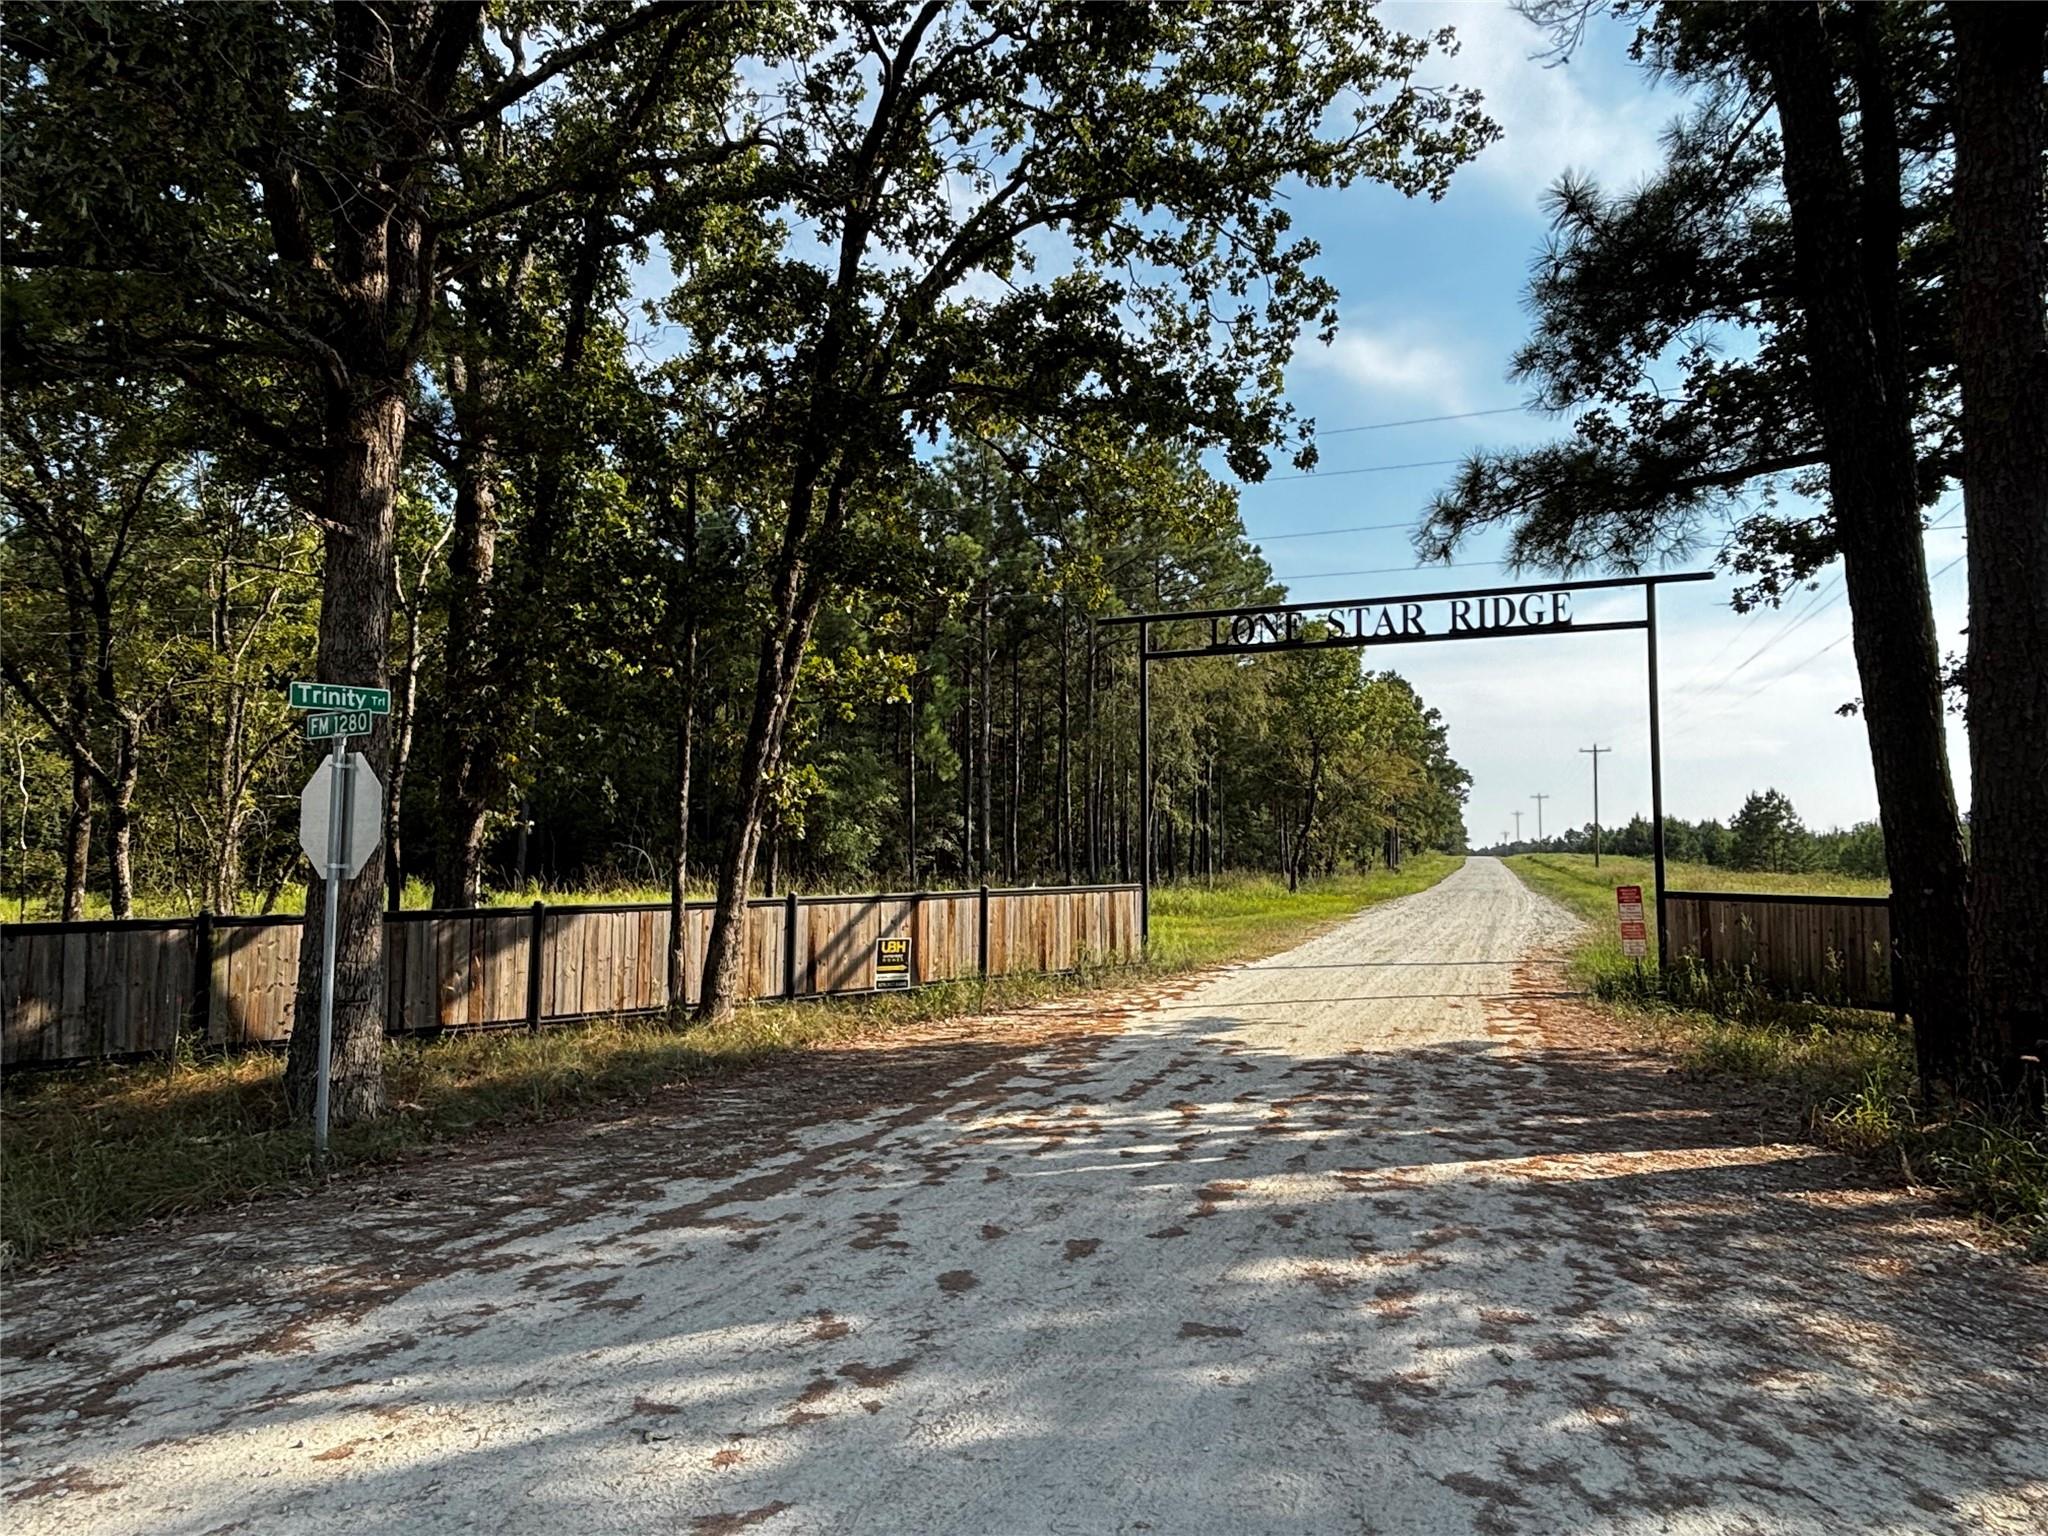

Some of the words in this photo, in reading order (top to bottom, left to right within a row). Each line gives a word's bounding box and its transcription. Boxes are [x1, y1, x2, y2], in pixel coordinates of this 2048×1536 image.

[1207, 612, 1302, 647] LONE
[1327, 603, 1426, 640] STAR
[1449, 592, 1573, 634] RIDGE
[298, 684, 367, 709] Trinity
[371, 696, 386, 707] Trl
[311, 717, 329, 735] FM
[334, 713, 367, 734] 1280
[881, 940, 906, 954] UBH
